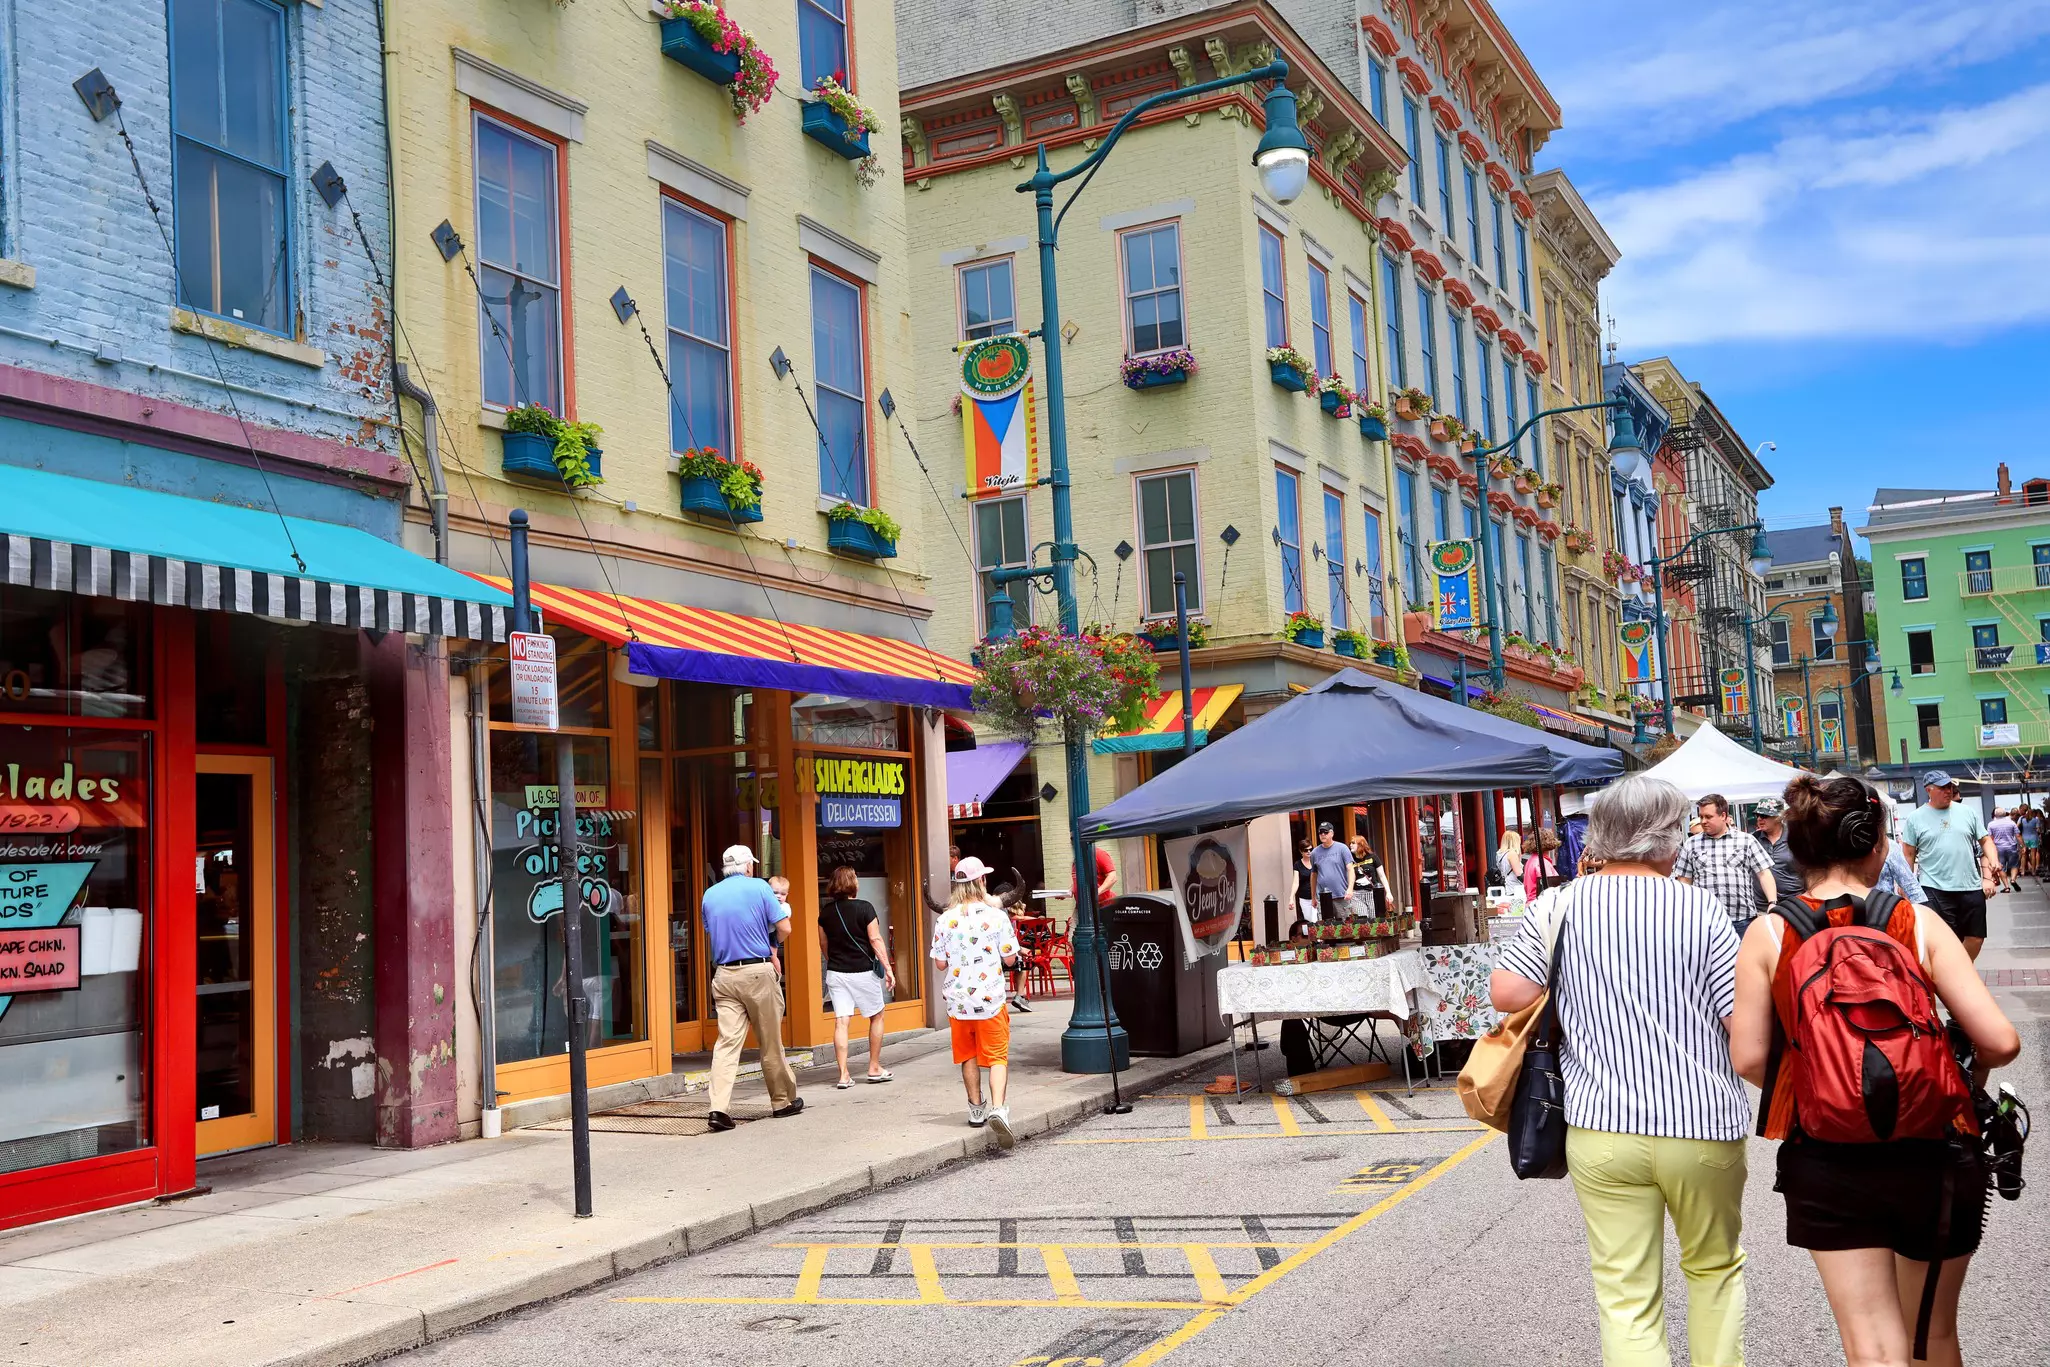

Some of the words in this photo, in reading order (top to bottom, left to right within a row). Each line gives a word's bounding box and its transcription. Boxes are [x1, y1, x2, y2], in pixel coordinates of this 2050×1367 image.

[968, 337, 1021, 362] FINDLAY
[974, 366, 1024, 392] MARKET
[513, 637, 526, 657] NO
[527, 639, 549, 650] PARKING
[527, 650, 553, 661] STANDING
[515, 663, 531, 672] TRUCK
[531, 665, 553, 674] LOADING
[516, 673, 524, 681] OR
[524, 674, 552, 684] UNLOADING
[531, 686, 539, 695] 15
[517, 696, 538, 705] MINUTE
[539, 697, 553, 706] LIMIT
[0, 762, 119, 802] lades
[815, 758, 905, 795] SILVERGLADES
[827, 803, 896, 823] DELICATESSEN
[525, 845, 607, 875] olies
[8, 869, 38, 883] OF
[1186, 881, 1218, 920] Teeny
[1217, 874, 1237, 913] Pies
[28, 939, 66, 953] CHKN.
[24, 961, 65, 979] SALAD
